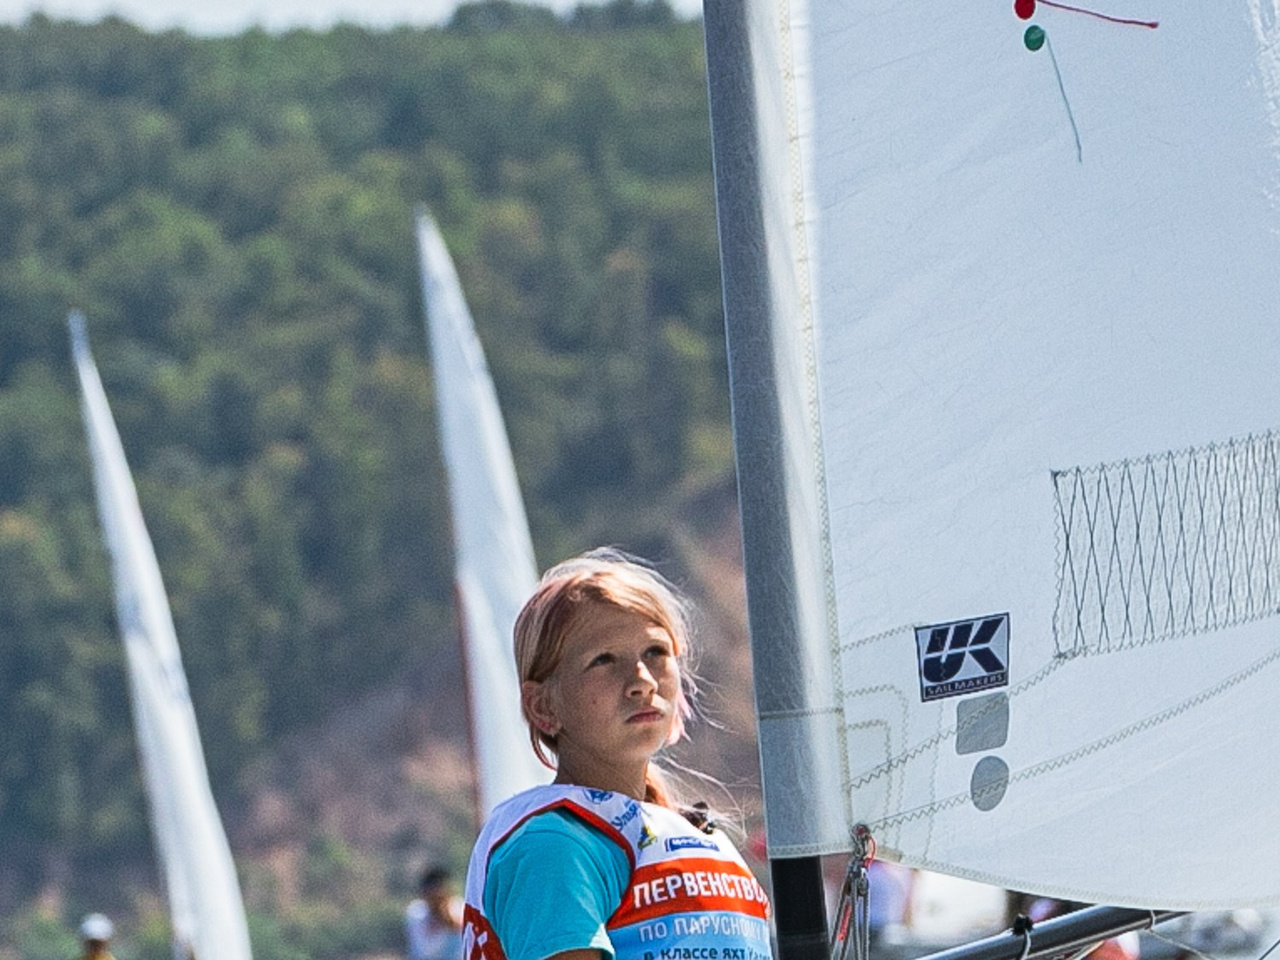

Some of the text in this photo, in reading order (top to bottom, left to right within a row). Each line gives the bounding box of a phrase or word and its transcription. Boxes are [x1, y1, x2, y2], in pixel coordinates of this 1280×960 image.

[923, 617, 1005, 683] UK
[639, 922, 667, 943] ПО
[661, 947, 718, 960] классе
[722, 947, 745, 960] яхт
